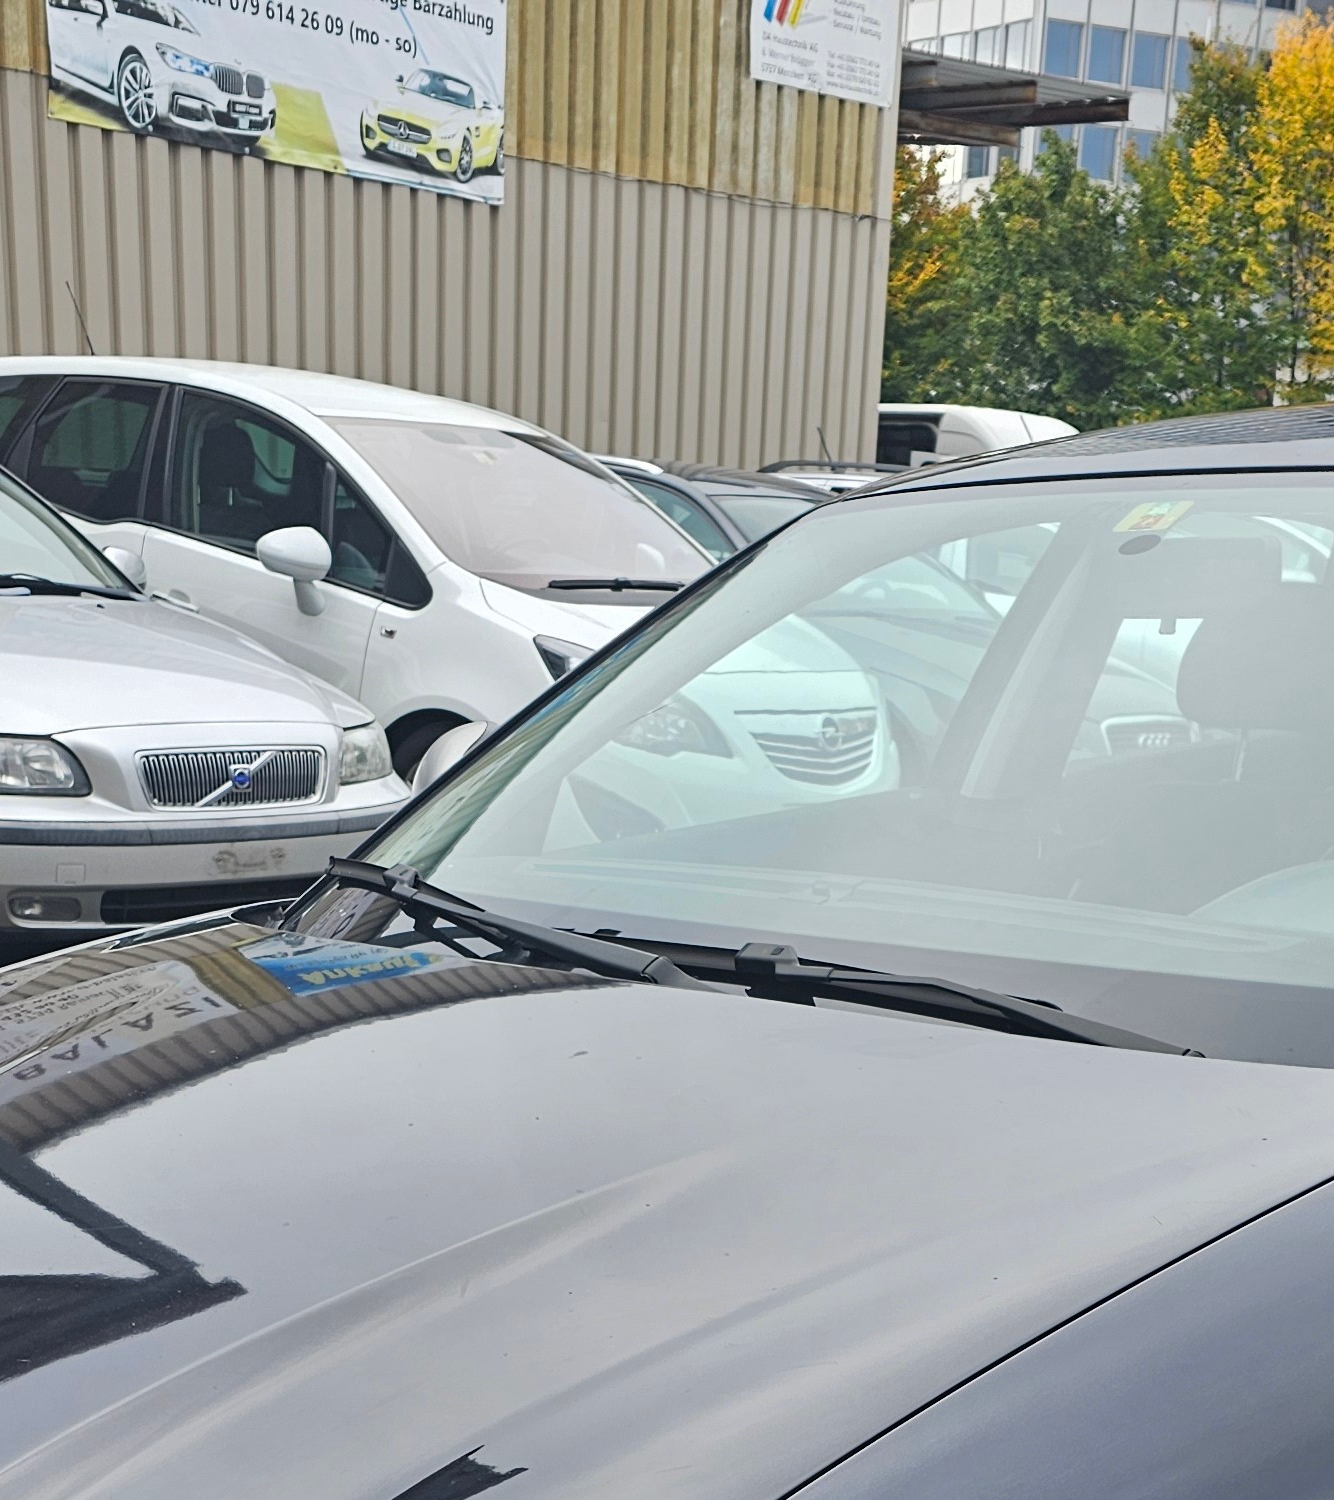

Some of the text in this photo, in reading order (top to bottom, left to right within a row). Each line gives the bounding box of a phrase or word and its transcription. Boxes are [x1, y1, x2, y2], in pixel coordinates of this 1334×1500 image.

[266, 1, 295, 26] 614
[300, 8, 320, 31] 26
[324, 14, 344, 36] 09
[349, 20, 380, 45] (mo
[395, 36, 417, 59] so)
[413, 0, 494, 35] Barzahlung
